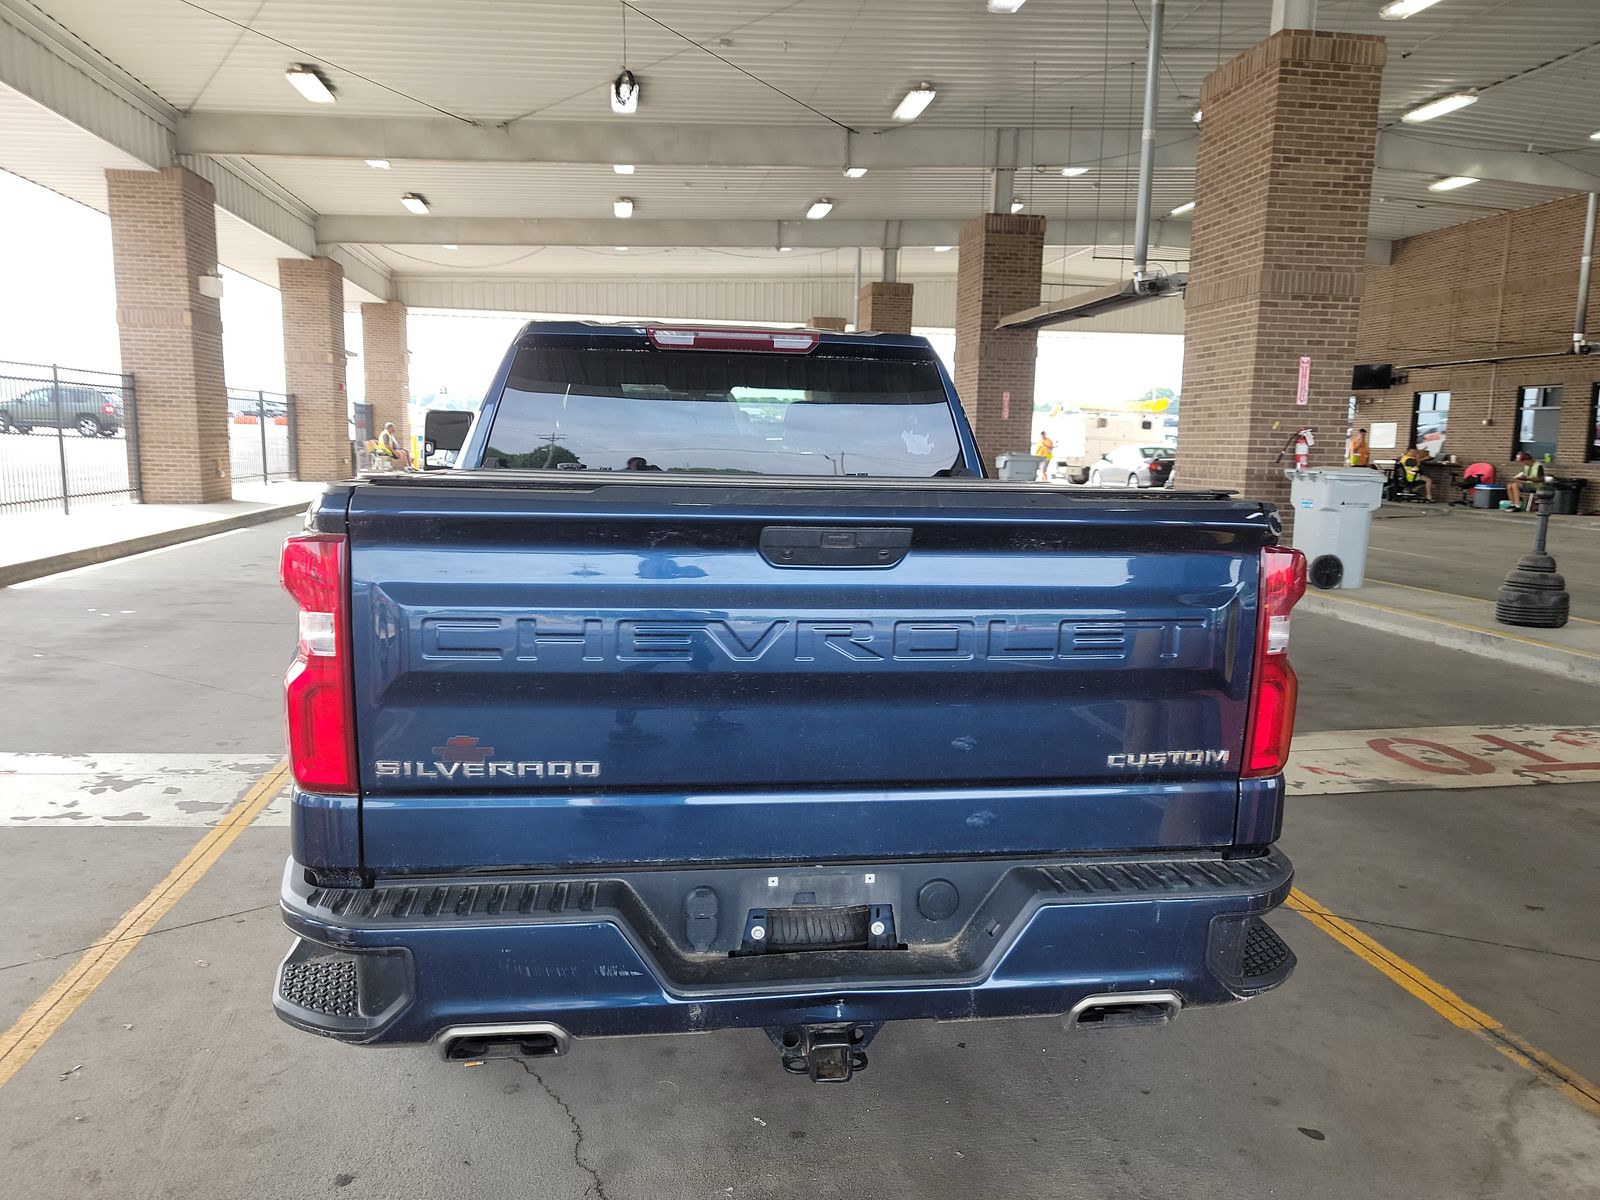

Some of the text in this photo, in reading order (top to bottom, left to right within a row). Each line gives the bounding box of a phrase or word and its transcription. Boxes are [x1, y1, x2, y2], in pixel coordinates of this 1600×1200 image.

[421, 616, 1207, 664] CHEVROLET
[375, 760, 601, 778] SILVERADO
[1107, 749, 1230, 769] CUSTOM
